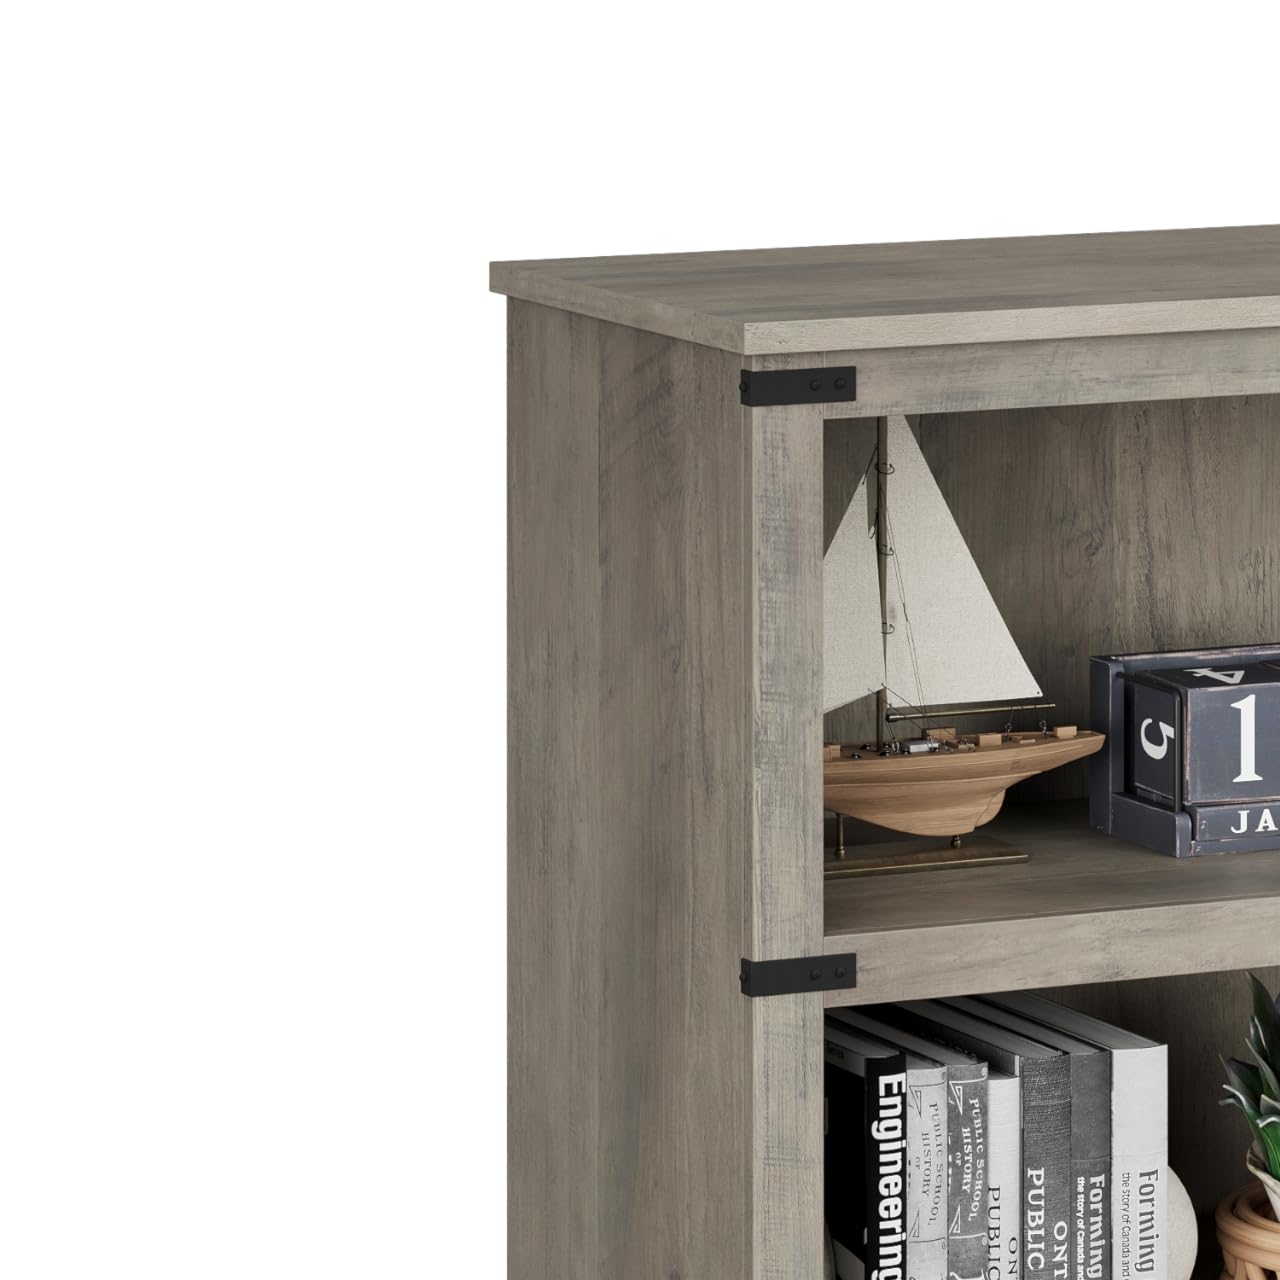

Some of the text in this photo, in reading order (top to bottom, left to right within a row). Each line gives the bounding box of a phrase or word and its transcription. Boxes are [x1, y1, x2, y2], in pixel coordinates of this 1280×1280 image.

[1184, 667, 1245, 684] 4
[1140, 718, 1175, 760] 5
[1230, 694, 1263, 783] 1
[916, 1157, 921, 1170] OF
[921, 1132, 932, 1197] HISTORY
[928, 1102, 943, 1226] PUBLIC SCHOOL
[956, 1152, 962, 1166] OF
[962, 1127, 973, 1193] HISTORY
[968, 1098, 984, 1222] PUBLIC SCHOOL
[1077, 1176, 1085, 1193] the
[1122, 1172, 1131, 1188] the
[1076, 1194, 1085, 1218] story
[1120, 1189, 1131, 1213] story
[1027, 1168, 1046, 1272] PUBLIC
[1077, 1219, 1085, 1229] of
[1086, 1173, 1106, 1279] Forming
[1122, 1214, 1131, 1225] of
[1134, 1168, 1160, 1272] Forming
[1077, 1230, 1085, 1263] Canada
[1121, 1226, 1131, 1258] Canada
[1122, 1259, 1131, 1277] and
